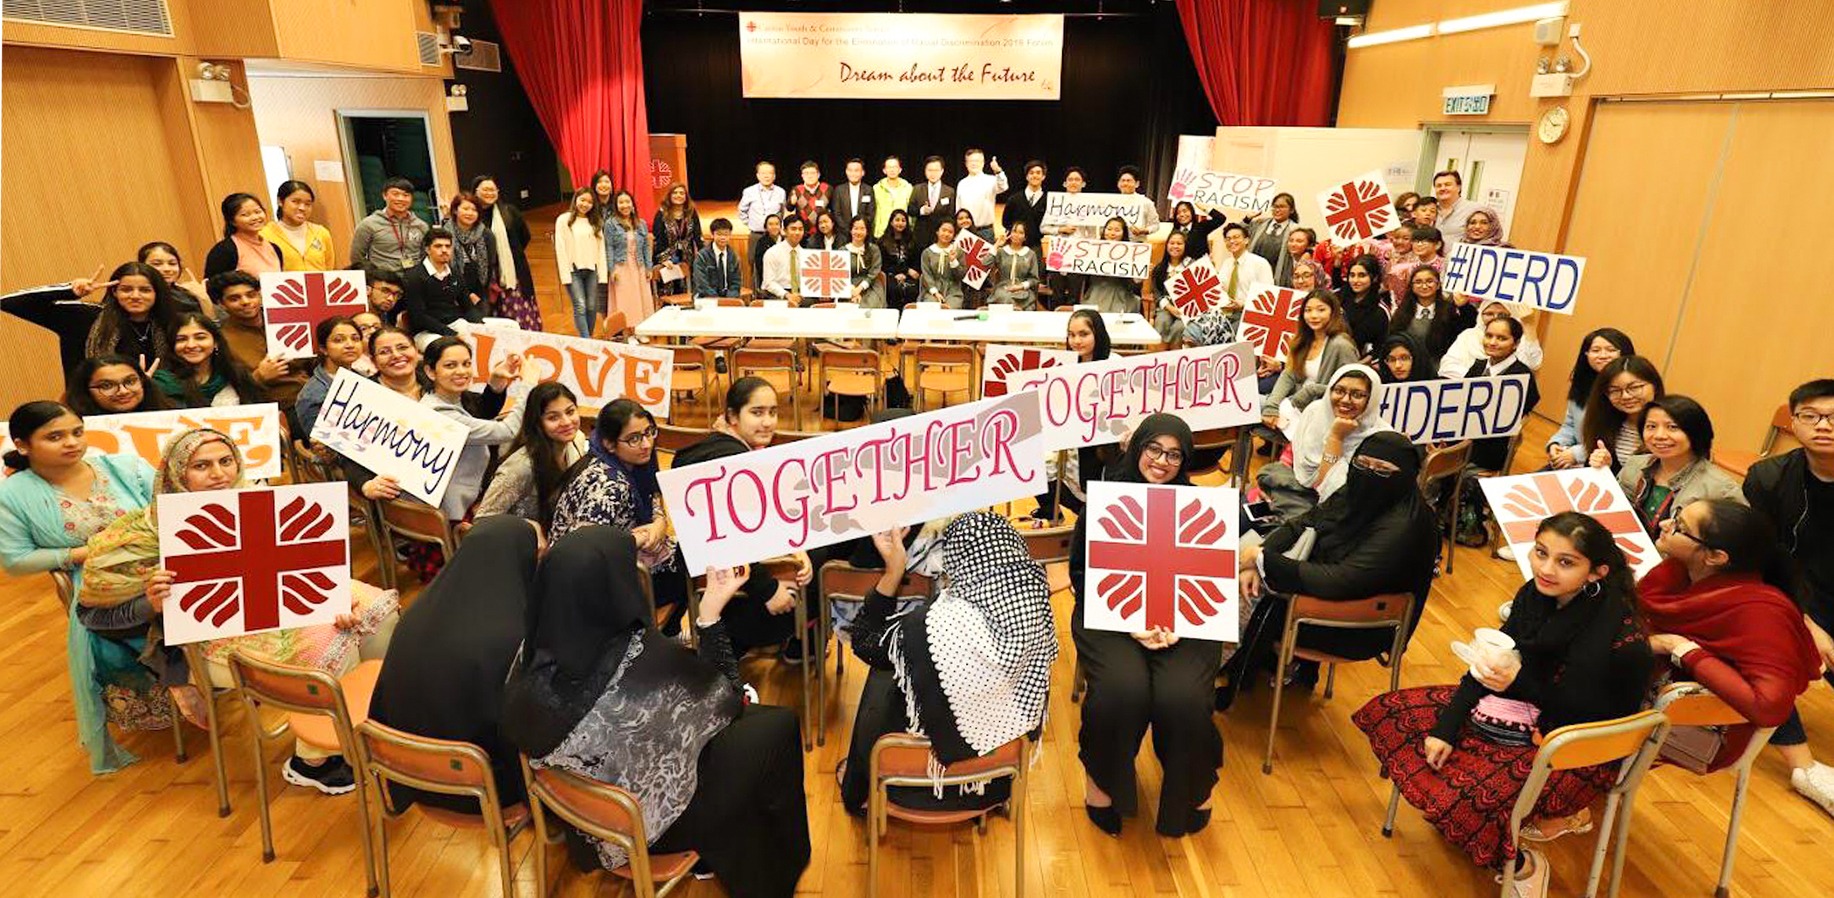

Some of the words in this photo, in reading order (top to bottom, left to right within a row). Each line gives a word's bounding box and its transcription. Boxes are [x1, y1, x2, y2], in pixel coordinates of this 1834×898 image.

[803, 36, 819, 47] Day
[821, 37, 833, 46] for
[836, 37, 848, 46] the
[941, 38, 1001, 47] Discrimination
[840, 62, 893, 83] Dream
[899, 63, 945, 82] about
[951, 63, 974, 82] the
[981, 63, 1035, 84] Future
[1198, 172, 1275, 196] STOP
[1050, 195, 1140, 224] Harmony
[1193, 190, 1270, 212] RACISM
[1074, 240, 1150, 261] STOP
[1073, 259, 1148, 278] RACISM
[1445, 245, 1579, 310] #IDERD
[323, 379, 454, 495] Harmony
[685, 409, 1035, 548] TOGETHER
